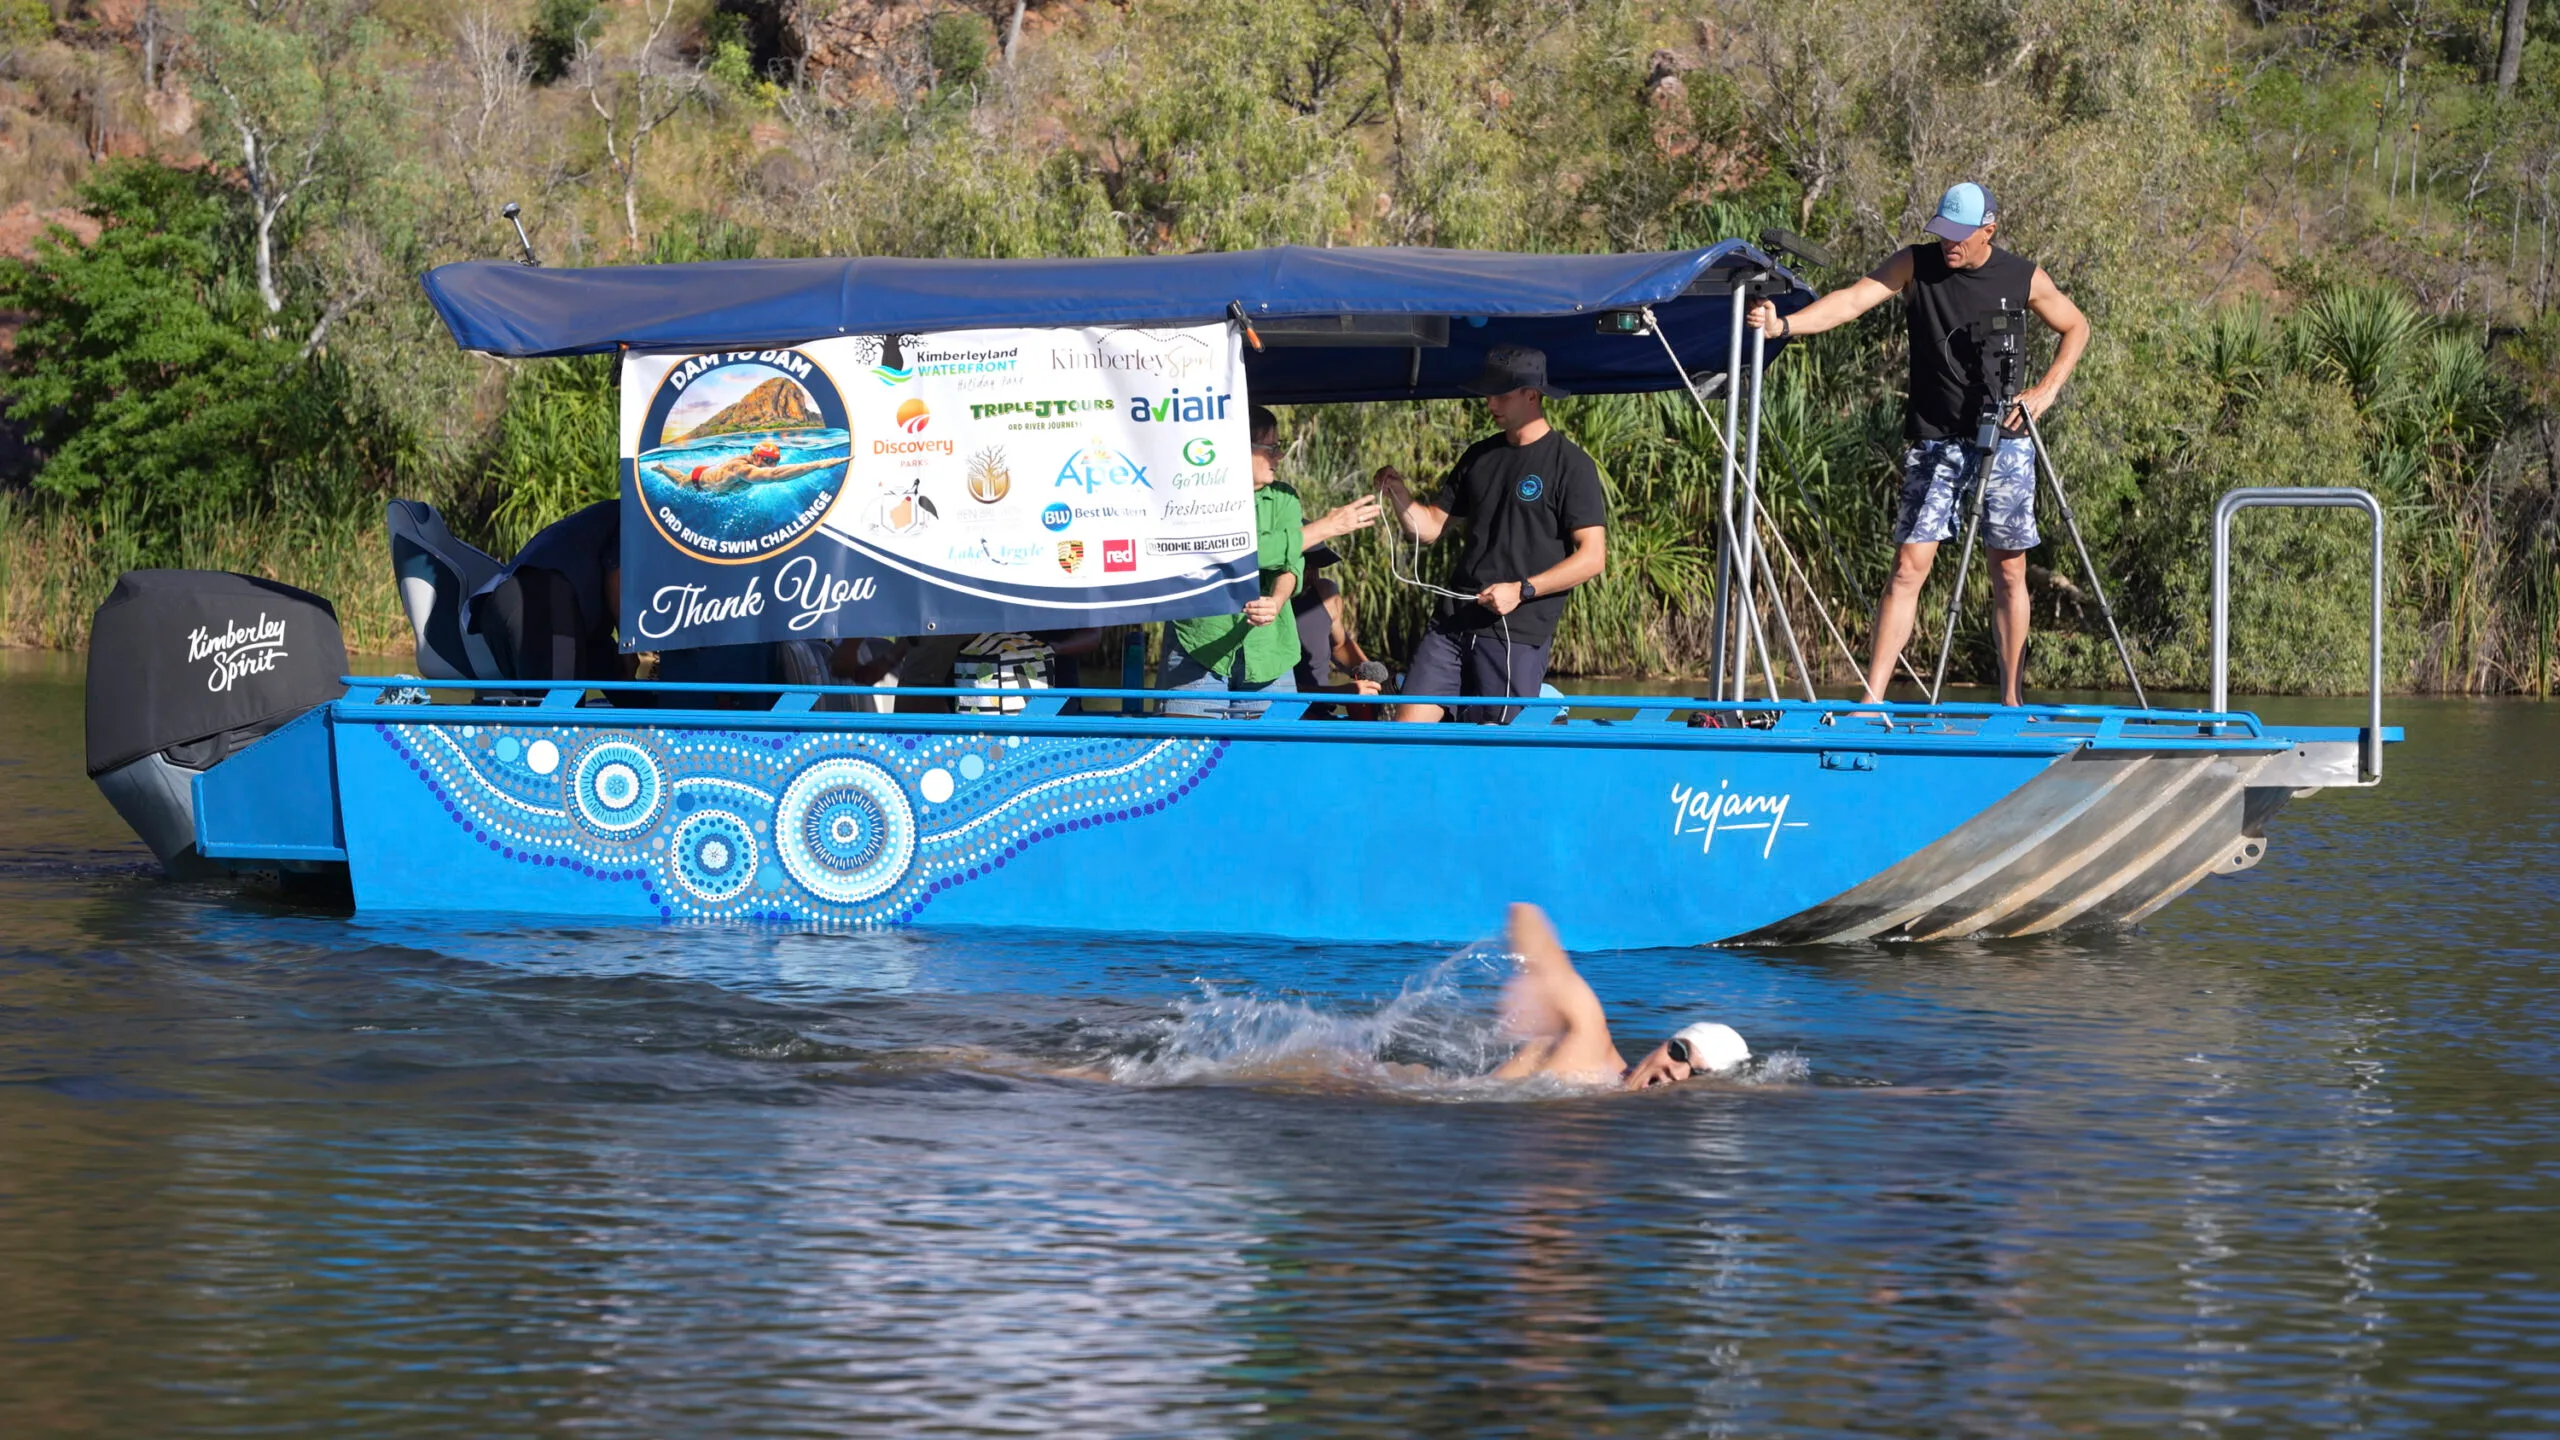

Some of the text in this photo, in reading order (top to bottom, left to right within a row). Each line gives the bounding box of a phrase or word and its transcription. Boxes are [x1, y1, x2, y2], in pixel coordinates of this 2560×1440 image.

[917, 347, 1018, 364] Kimberleyland
[1052, 348, 1164, 376] Kimberley
[670, 350, 813, 391] DAM TO DAM
[918, 359, 1017, 377] WATERFRONT
[970, 401, 1034, 420] TRIPLE
[1131, 386, 1231, 422] aviair
[1008, 423, 1023, 431] ORD
[1024, 421, 1046, 430] RIVER
[873, 439, 954, 455] Discovery
[1054, 448, 1155, 494] Apex
[1045, 510, 1070, 525] BW
[1075, 507, 1100, 518] Best
[1160, 499, 1246, 521] freshwater
[659, 490, 833, 553] ORD RIVER SWIM CHALLENGE
[948, 546, 984, 560] Lake
[1107, 540, 1133, 564] red
[1193, 538, 1229, 551] BEACH
[1231, 536, 1246, 547] CO
[638, 555, 877, 638] Thank You
[188, 612, 286, 663] Kimberley
[208, 648, 288, 692] Spirit
